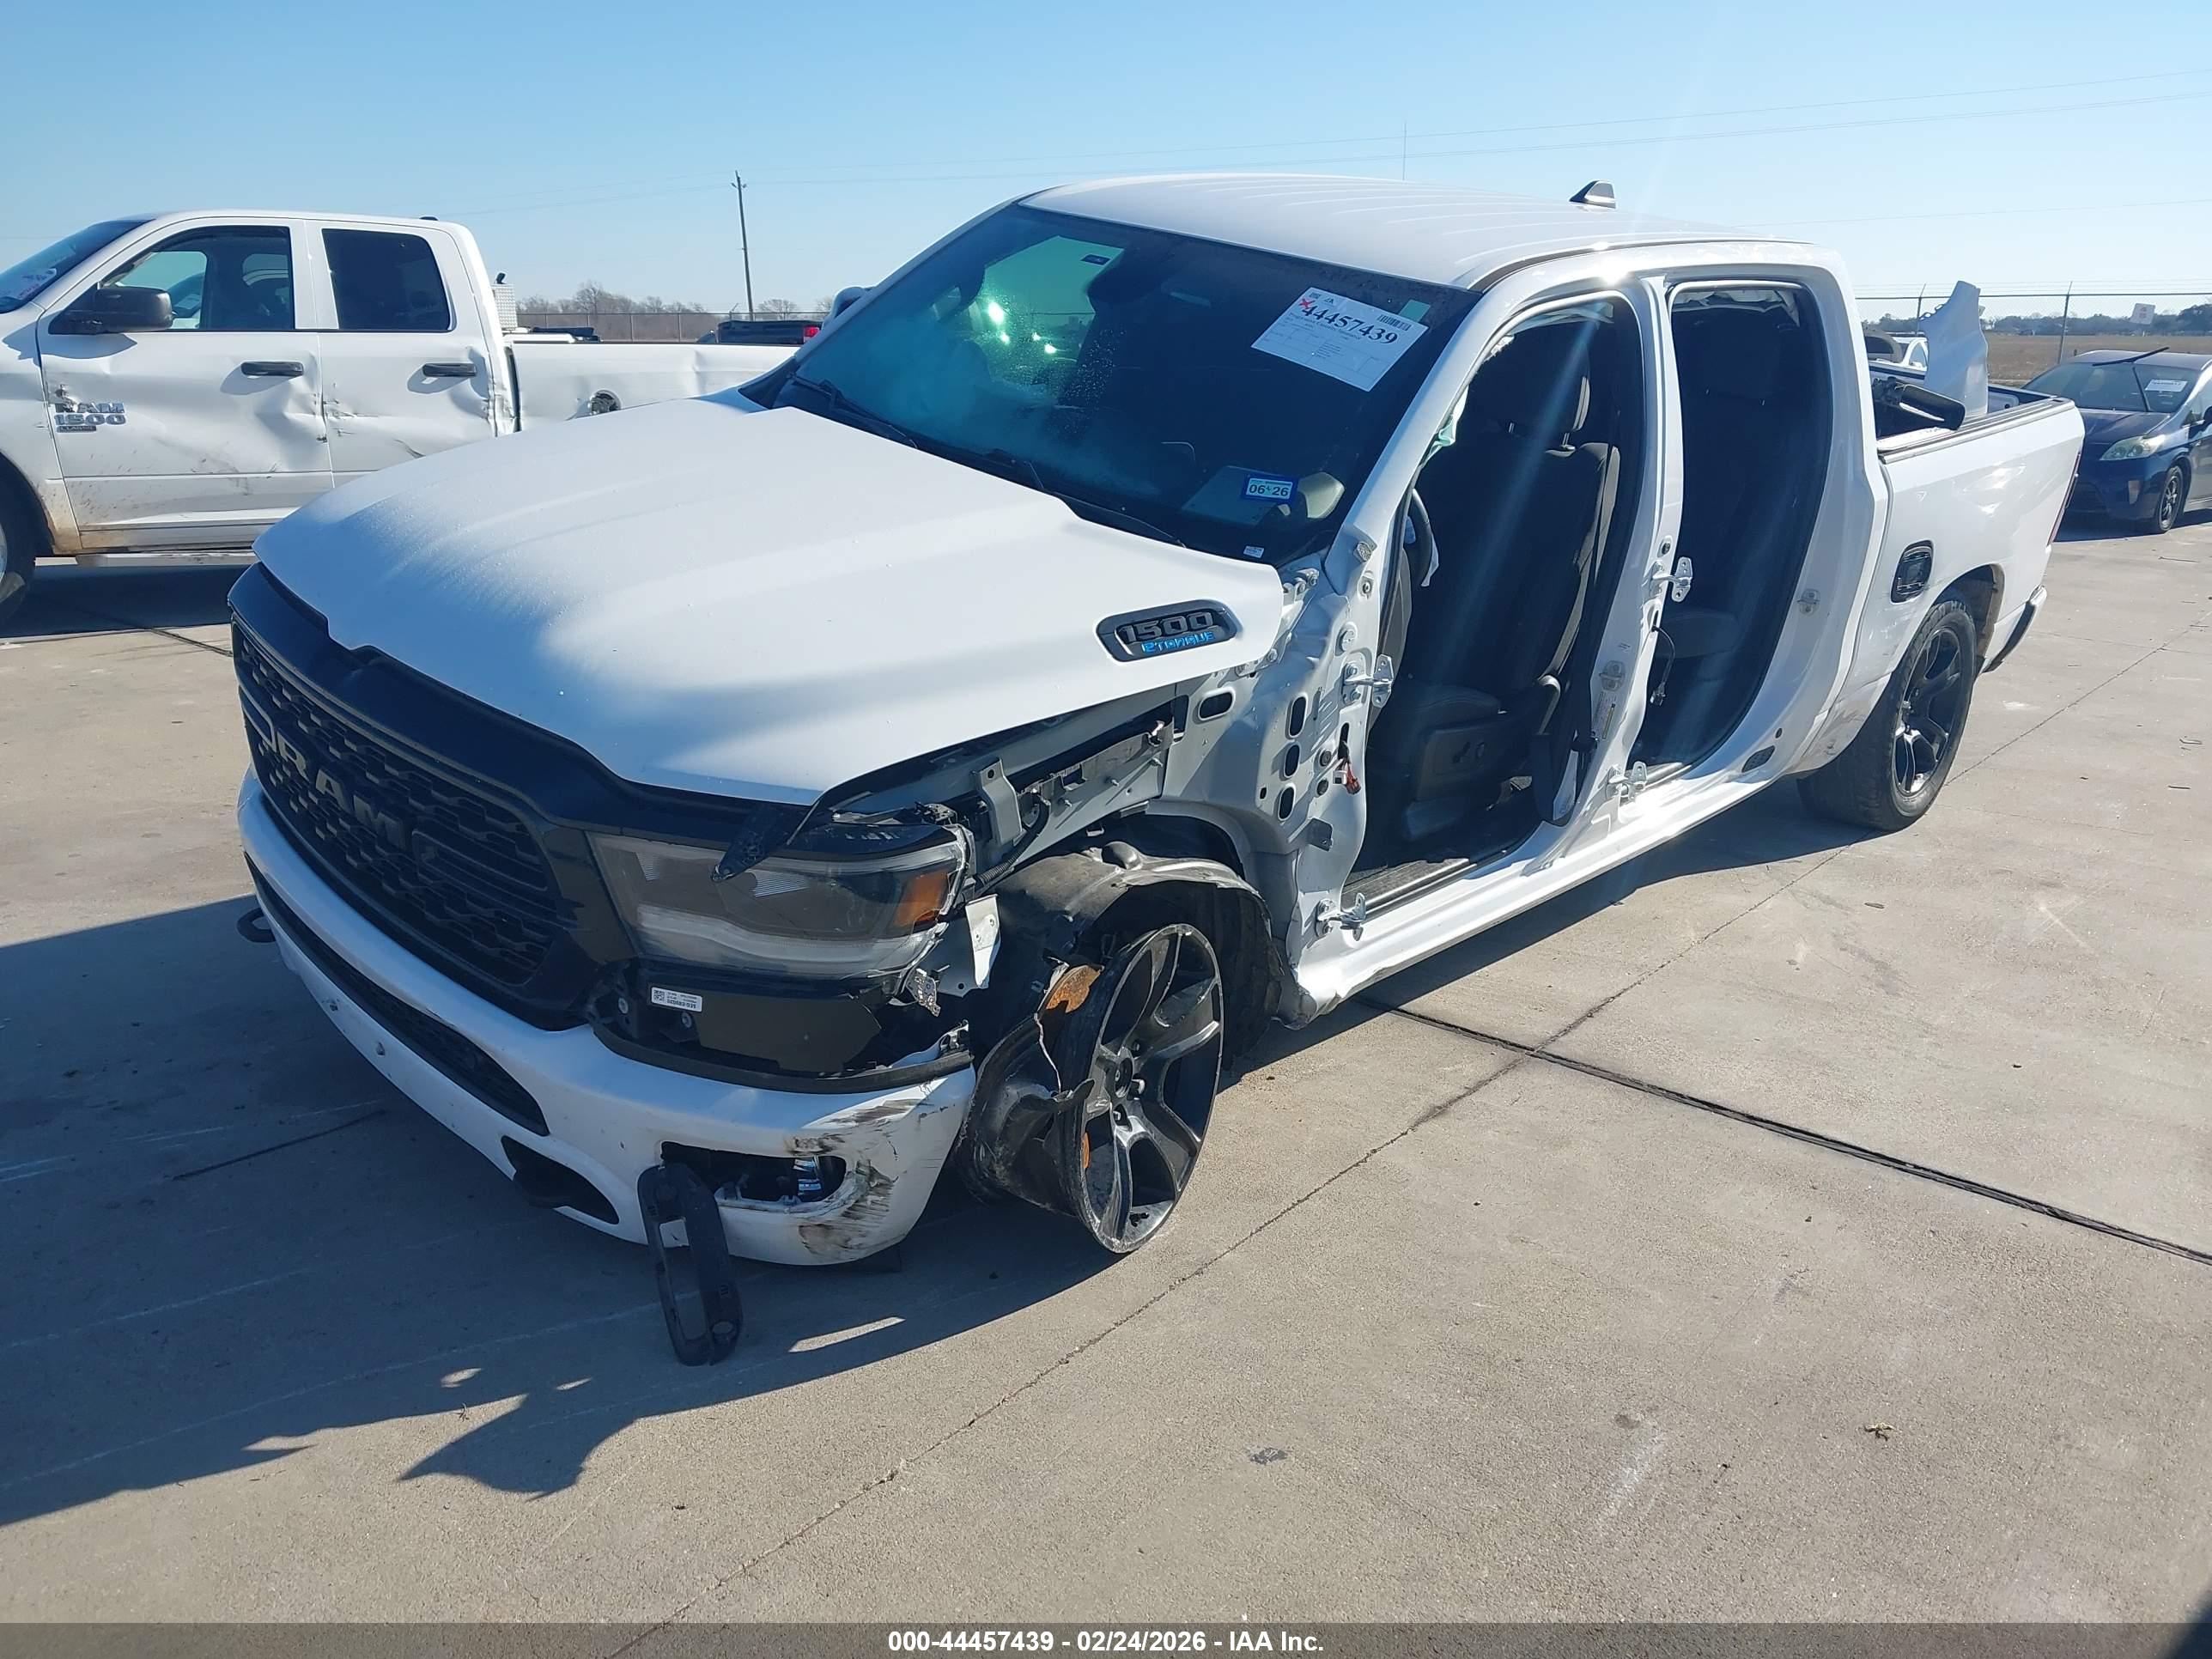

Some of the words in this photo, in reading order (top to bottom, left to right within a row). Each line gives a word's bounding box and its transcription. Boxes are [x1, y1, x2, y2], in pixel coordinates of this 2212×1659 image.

[1302, 305, 1398, 344] 44457439
[54, 414, 126, 425] 1500
[1249, 484, 1265, 495] 06
[1272, 486, 1289, 496] 26
[1118, 611, 1213, 643] 1500
[276, 732, 406, 847] RAM
